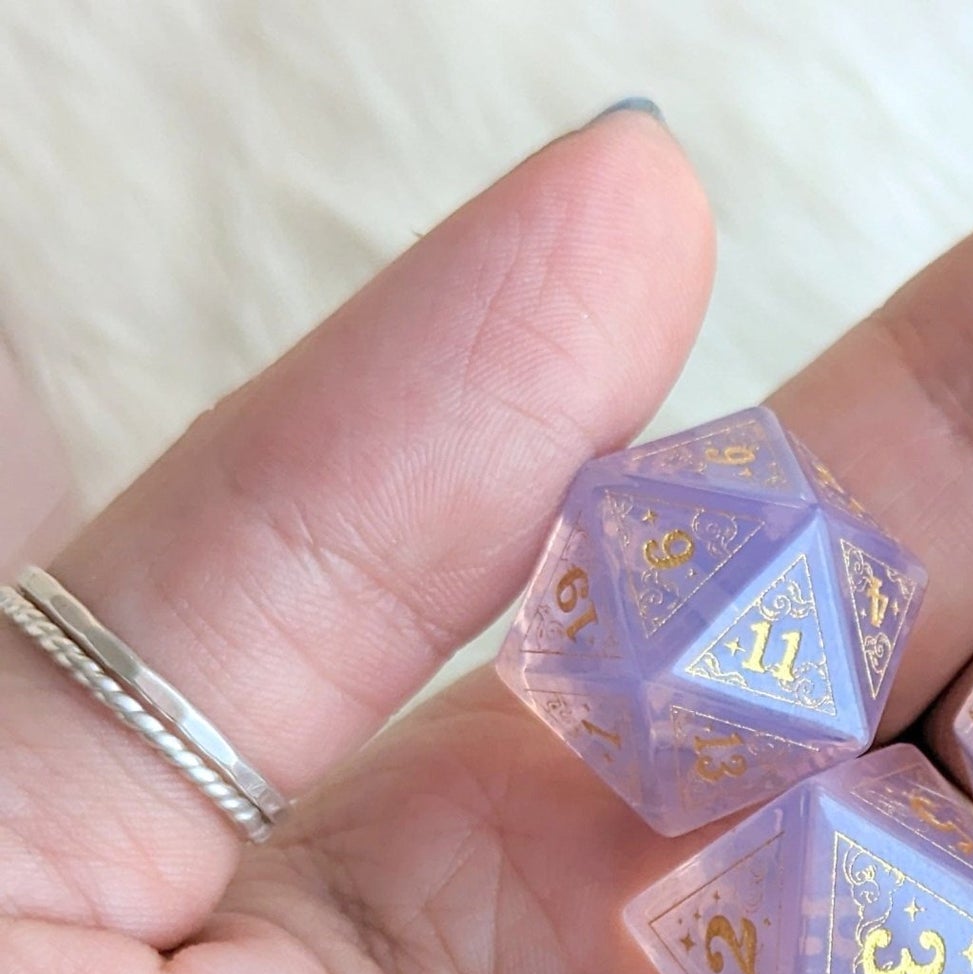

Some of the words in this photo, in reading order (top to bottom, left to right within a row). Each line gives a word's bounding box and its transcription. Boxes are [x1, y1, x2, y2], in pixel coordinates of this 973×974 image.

[555, 564, 599, 643] 19
[866, 576, 889, 628] 4
[742, 619, 803, 682] 11
[694, 731, 747, 783] 13
